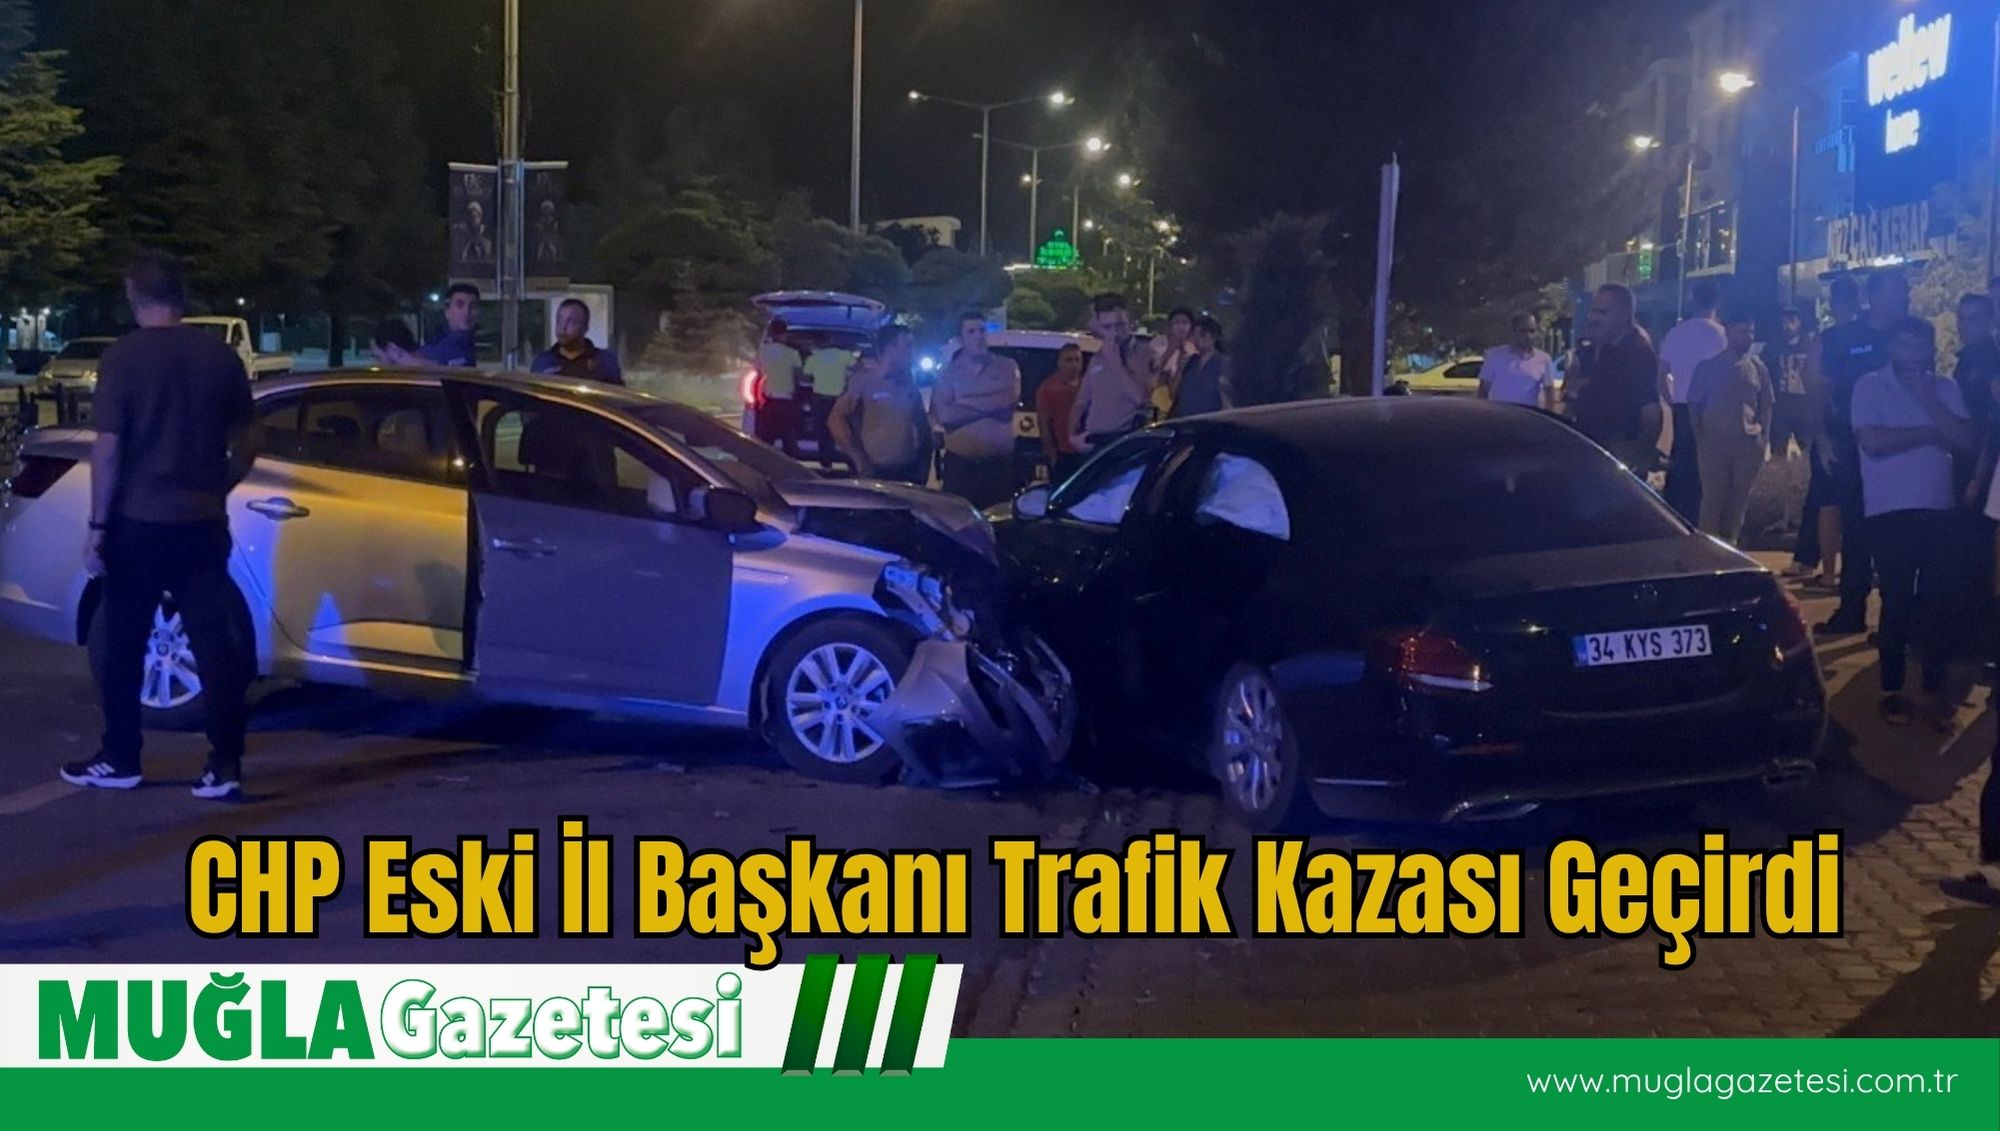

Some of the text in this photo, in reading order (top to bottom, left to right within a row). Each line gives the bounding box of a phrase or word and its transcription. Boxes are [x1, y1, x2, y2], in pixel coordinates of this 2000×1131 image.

[1588, 635, 1615, 662] 34
[1623, 631, 1663, 659] KYS
[1670, 627, 1708, 655] 373
